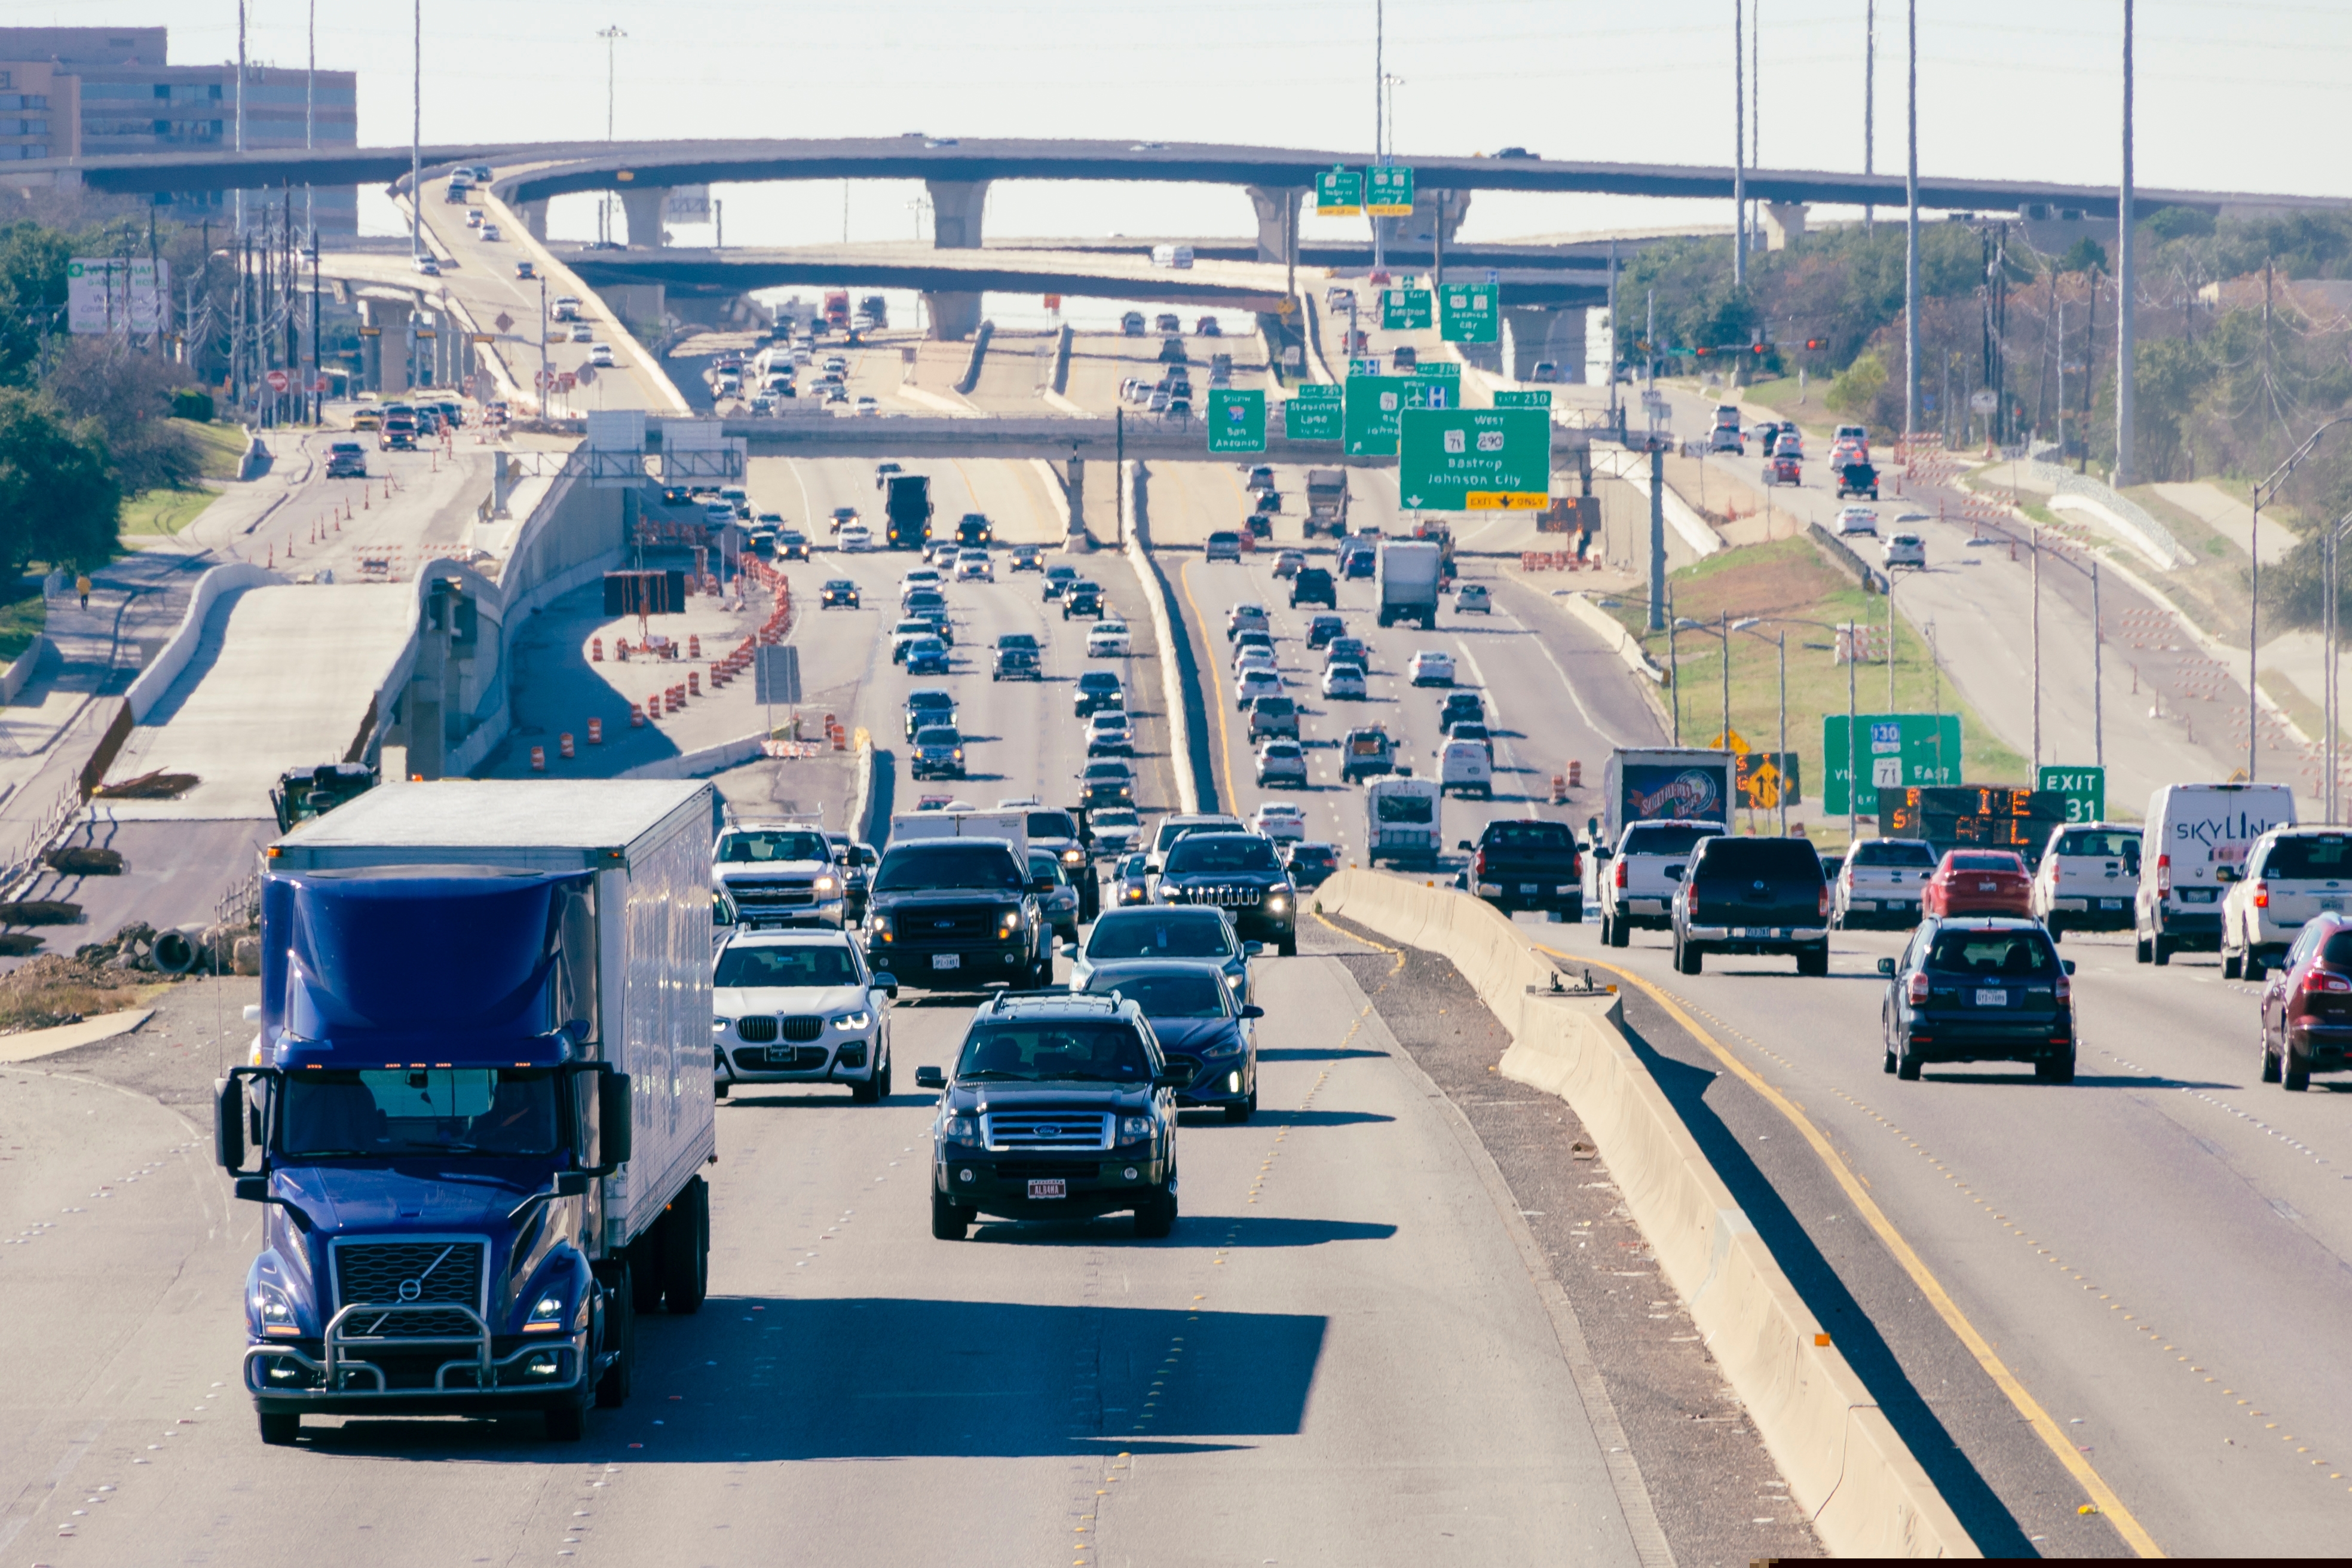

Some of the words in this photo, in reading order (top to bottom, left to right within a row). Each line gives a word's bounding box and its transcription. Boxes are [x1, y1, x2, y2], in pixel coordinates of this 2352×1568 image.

[1449, 437, 1462, 451] 71
[1478, 436, 1503, 449] 290
[1448, 458, 1503, 472] Bastrop
[1428, 473, 1488, 486] Johnson
[1494, 473, 1521, 488] City
[1873, 726, 1898, 740] 130
[1879, 768, 1897, 784] 71
[2046, 774, 2096, 791] EXIT
[2066, 798, 2095, 823] 31
